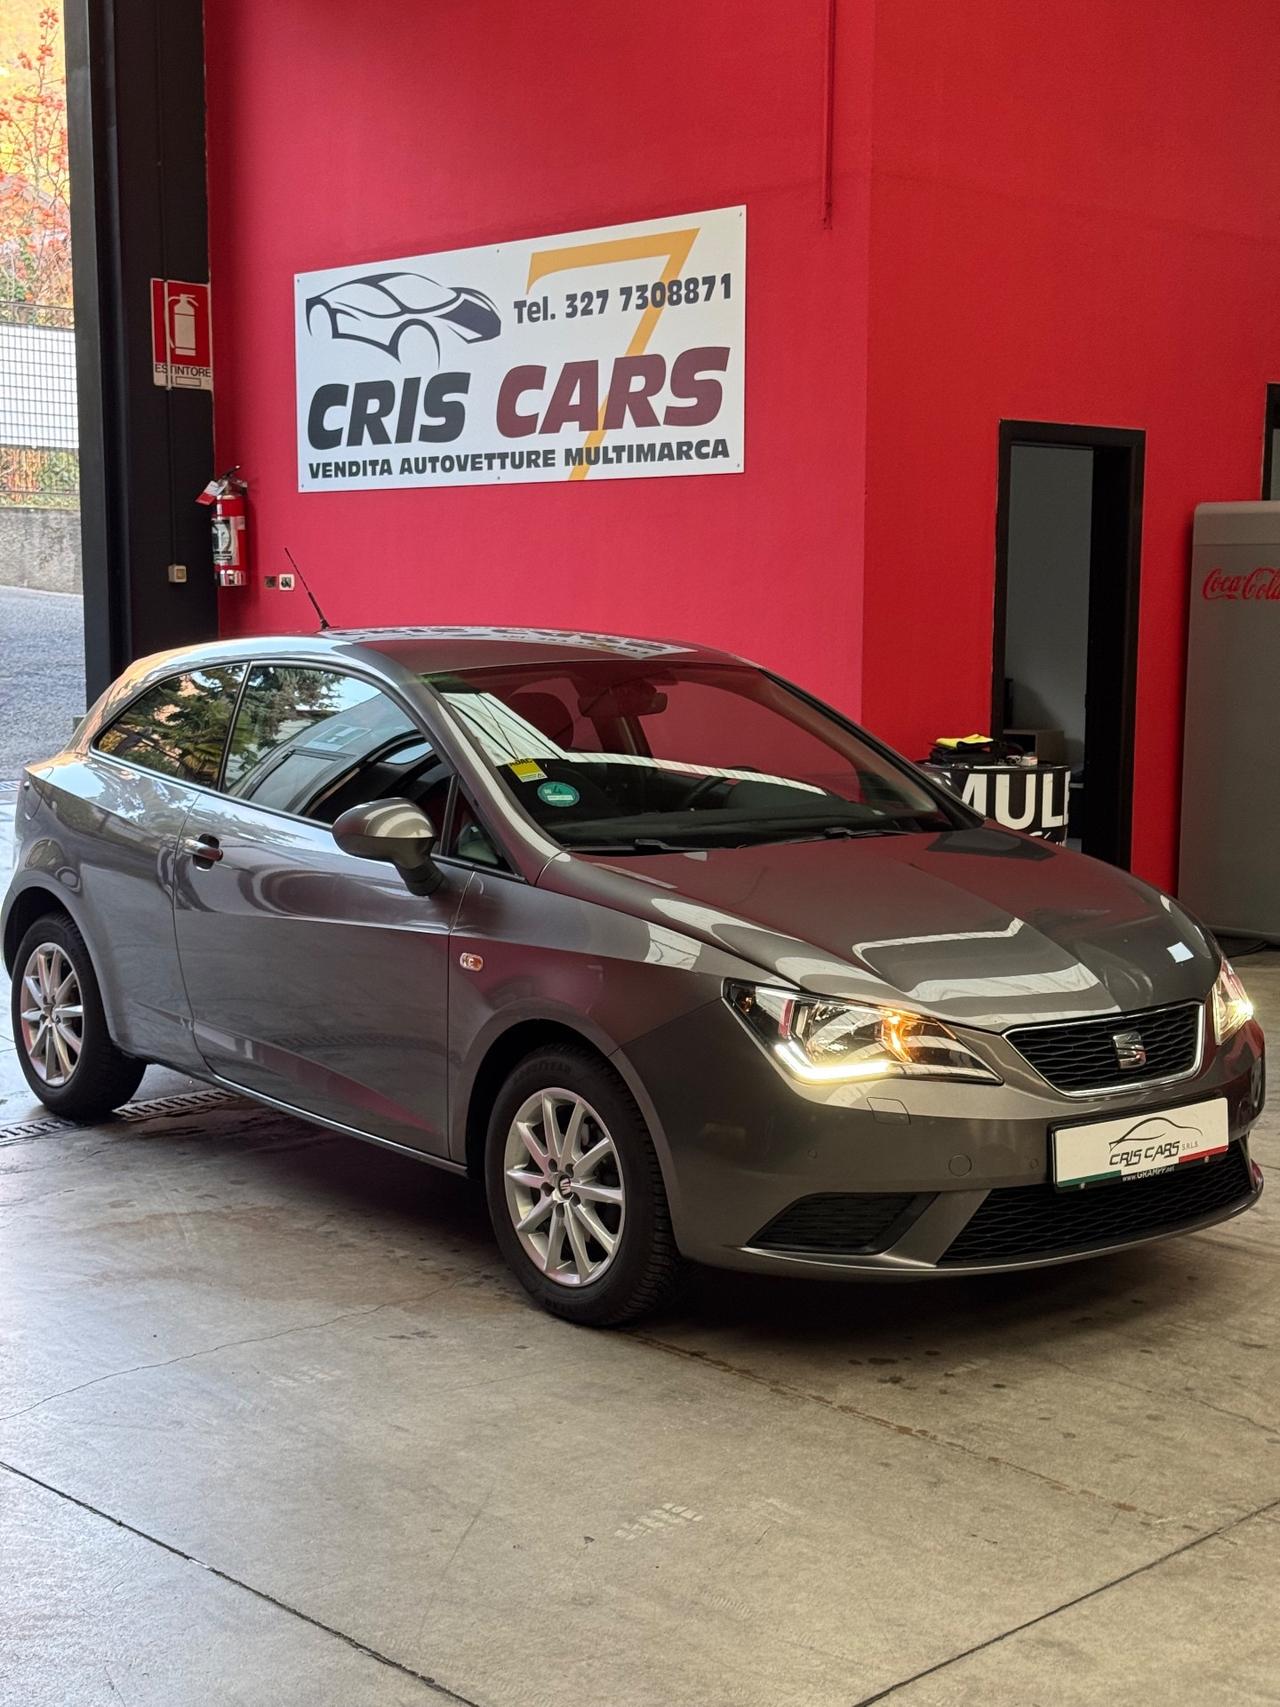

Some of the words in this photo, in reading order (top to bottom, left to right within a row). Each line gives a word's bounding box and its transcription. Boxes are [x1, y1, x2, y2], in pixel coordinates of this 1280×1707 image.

[513, 296, 556, 324] Tel.
[565, 289, 609, 318] 327
[619, 273, 732, 312] 7308871
[307, 372, 471, 450] CRIS
[496, 346, 731, 438] CARS
[308, 459, 393, 479] VENDITA
[399, 449, 556, 475] AUTOVETTURE
[564, 438, 730, 467] MULTIMARCA
[1109, 1149, 1143, 1167] CRIS
[1144, 1140, 1180, 1162] CARS
